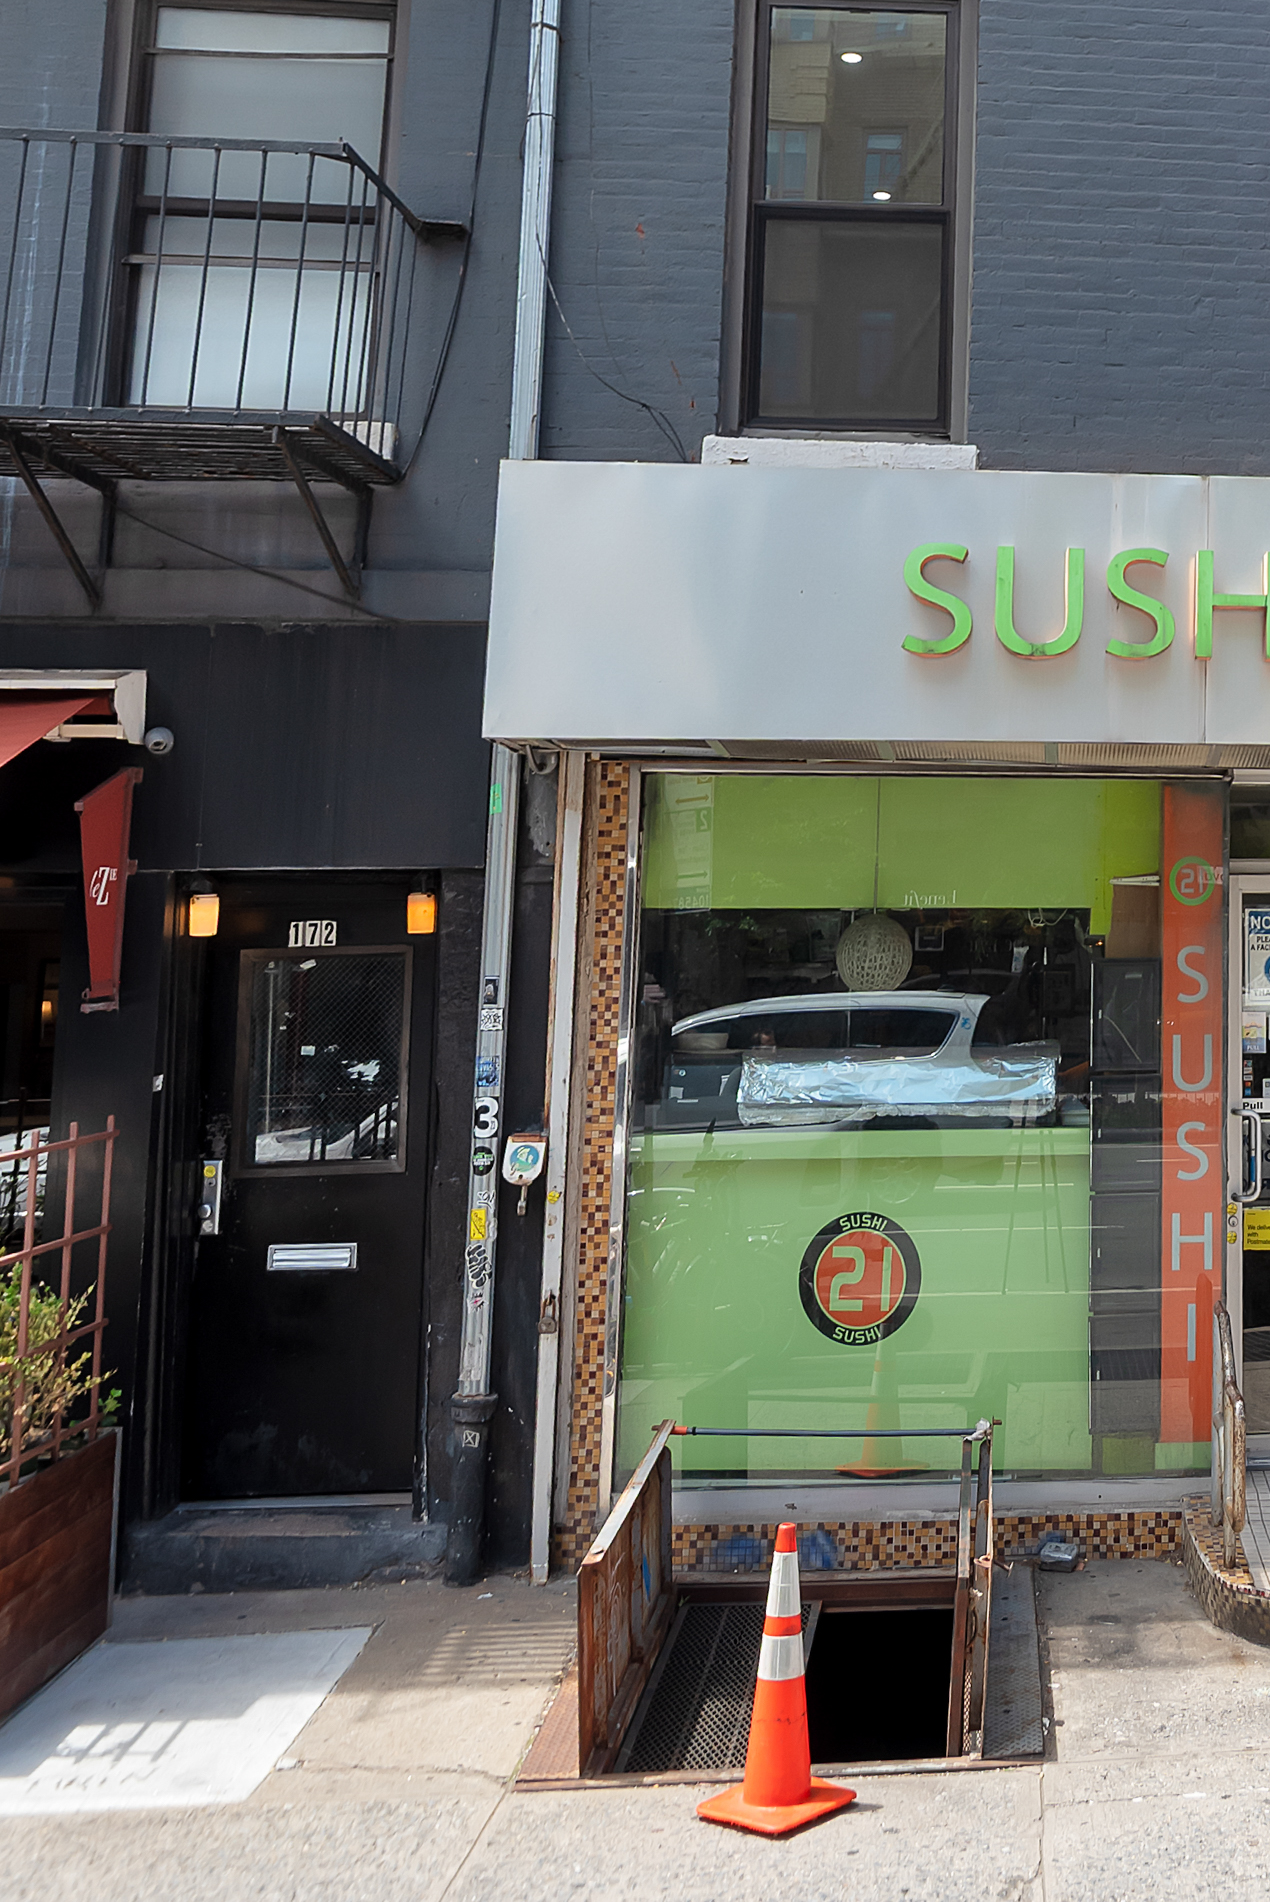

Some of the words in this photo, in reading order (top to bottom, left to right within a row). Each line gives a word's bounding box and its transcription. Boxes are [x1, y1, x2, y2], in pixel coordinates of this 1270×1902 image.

[1181, 868, 1204, 893] 21
[291, 921, 336, 947] 172
[1242, 1101, 1263, 1110] Pull
[1171, 945, 1213, 1362] SUSHI
[839, 1214, 888, 1231] SUSHI
[829, 1245, 893, 1312] 21
[832, 1326, 881, 1344] SUSHI
